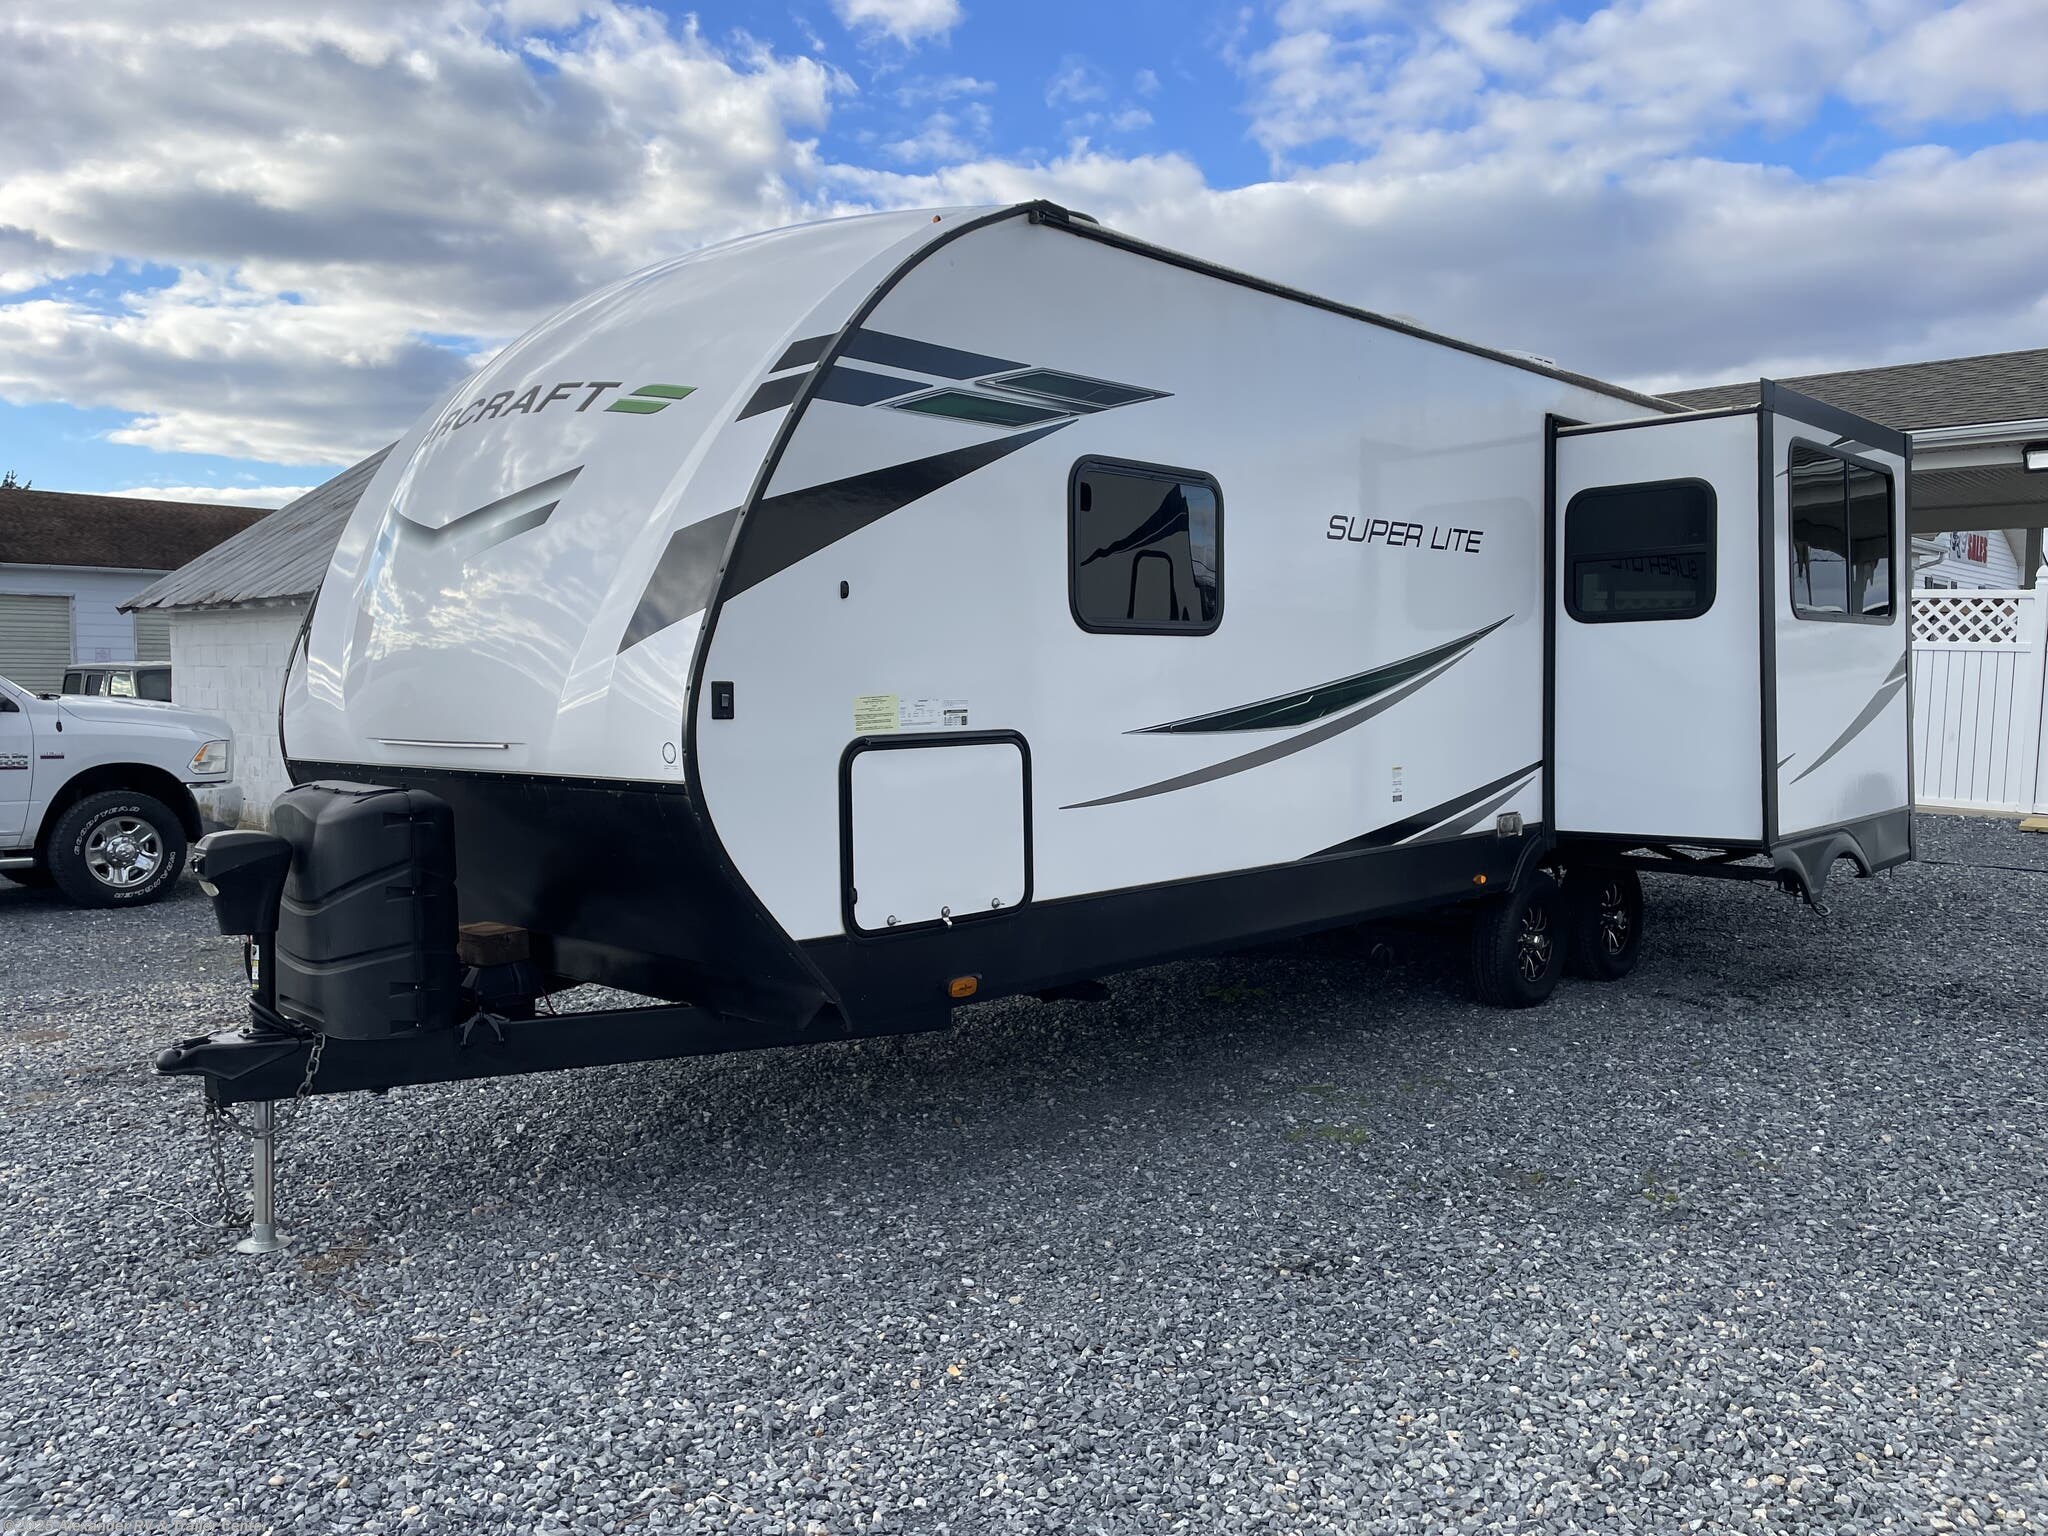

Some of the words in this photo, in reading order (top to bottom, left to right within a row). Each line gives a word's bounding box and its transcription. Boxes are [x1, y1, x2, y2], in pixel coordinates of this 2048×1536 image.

[1326, 514, 1424, 548] SUPER
[1430, 526, 1484, 554] LITE
[73, 805, 140, 856] GOODYEAR
